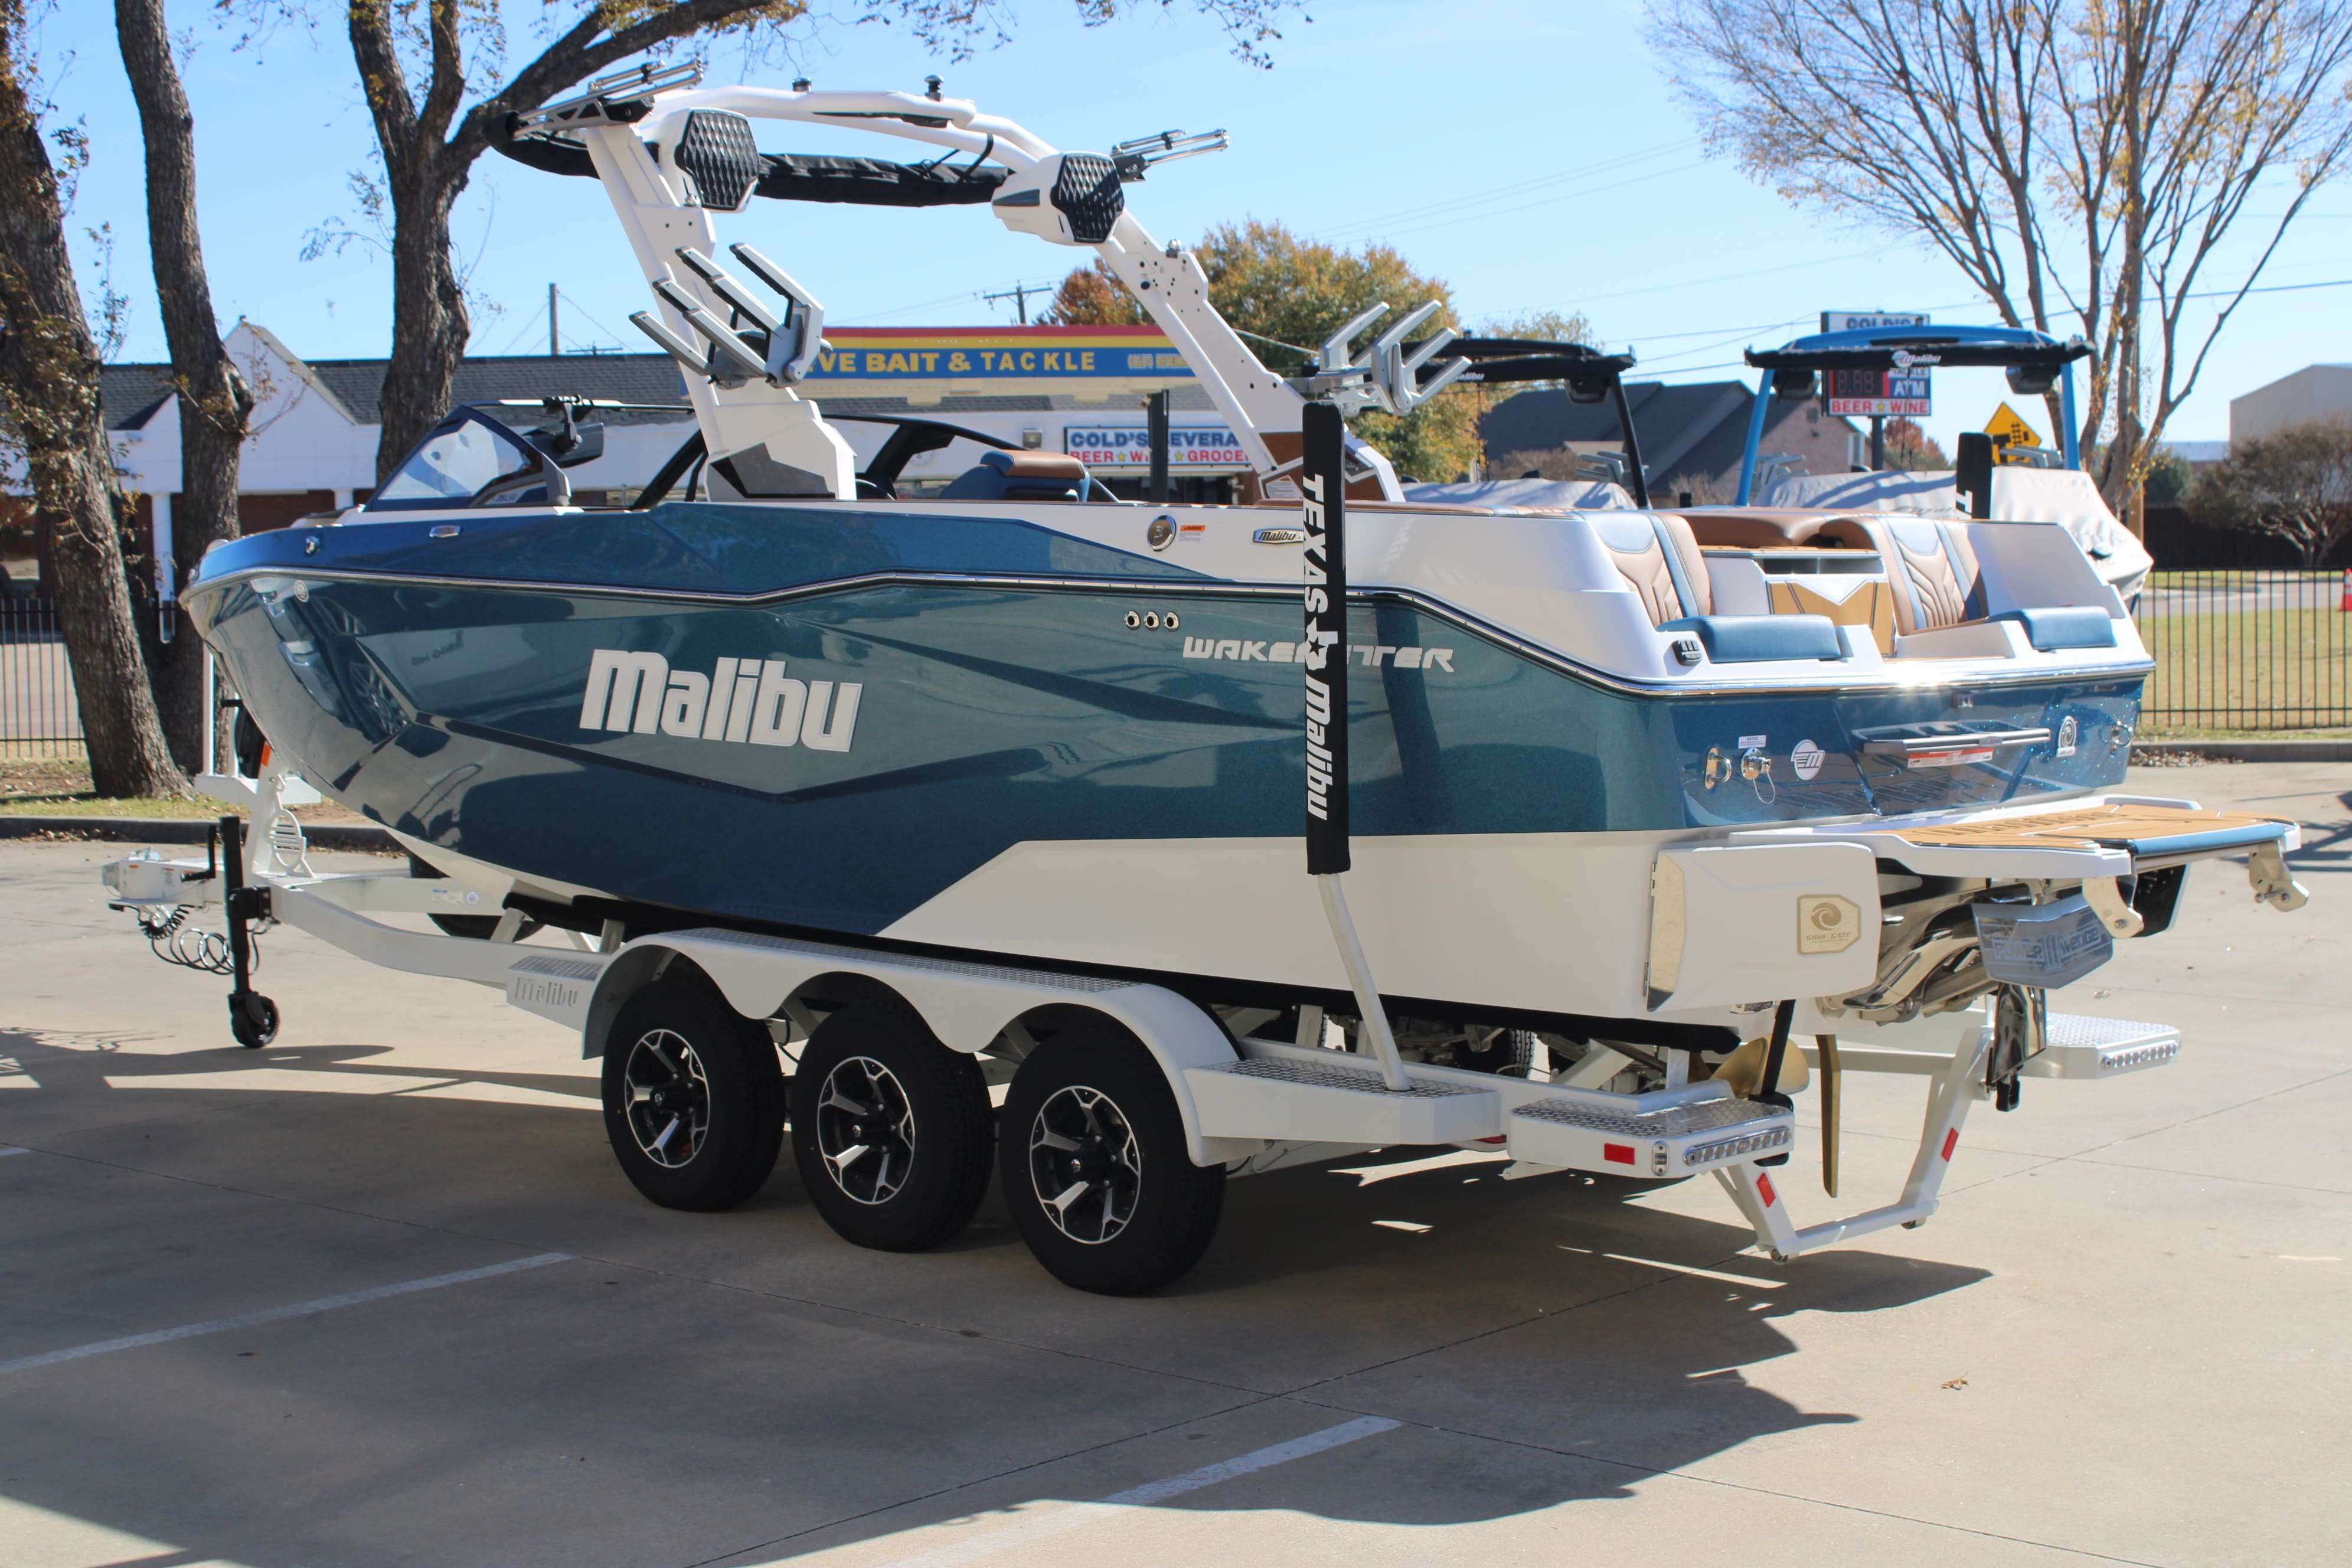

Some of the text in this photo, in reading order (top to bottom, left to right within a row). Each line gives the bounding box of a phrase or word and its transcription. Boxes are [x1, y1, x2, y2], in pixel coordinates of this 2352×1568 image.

[866, 352, 940, 373] BAIT
[948, 352, 972, 373] &
[980, 351, 1096, 371] TACKLE
[1893, 381, 1926, 397] ATM
[1832, 401, 1928, 413] BEER WINE
[1258, 531, 1296, 541] Malibu
[1182, 636, 1454, 672] WAKETTER
[1303, 473, 1333, 821] TEXAS Malibu
[579, 649, 863, 753] Malibu
[514, 977, 578, 1007] Malibu
